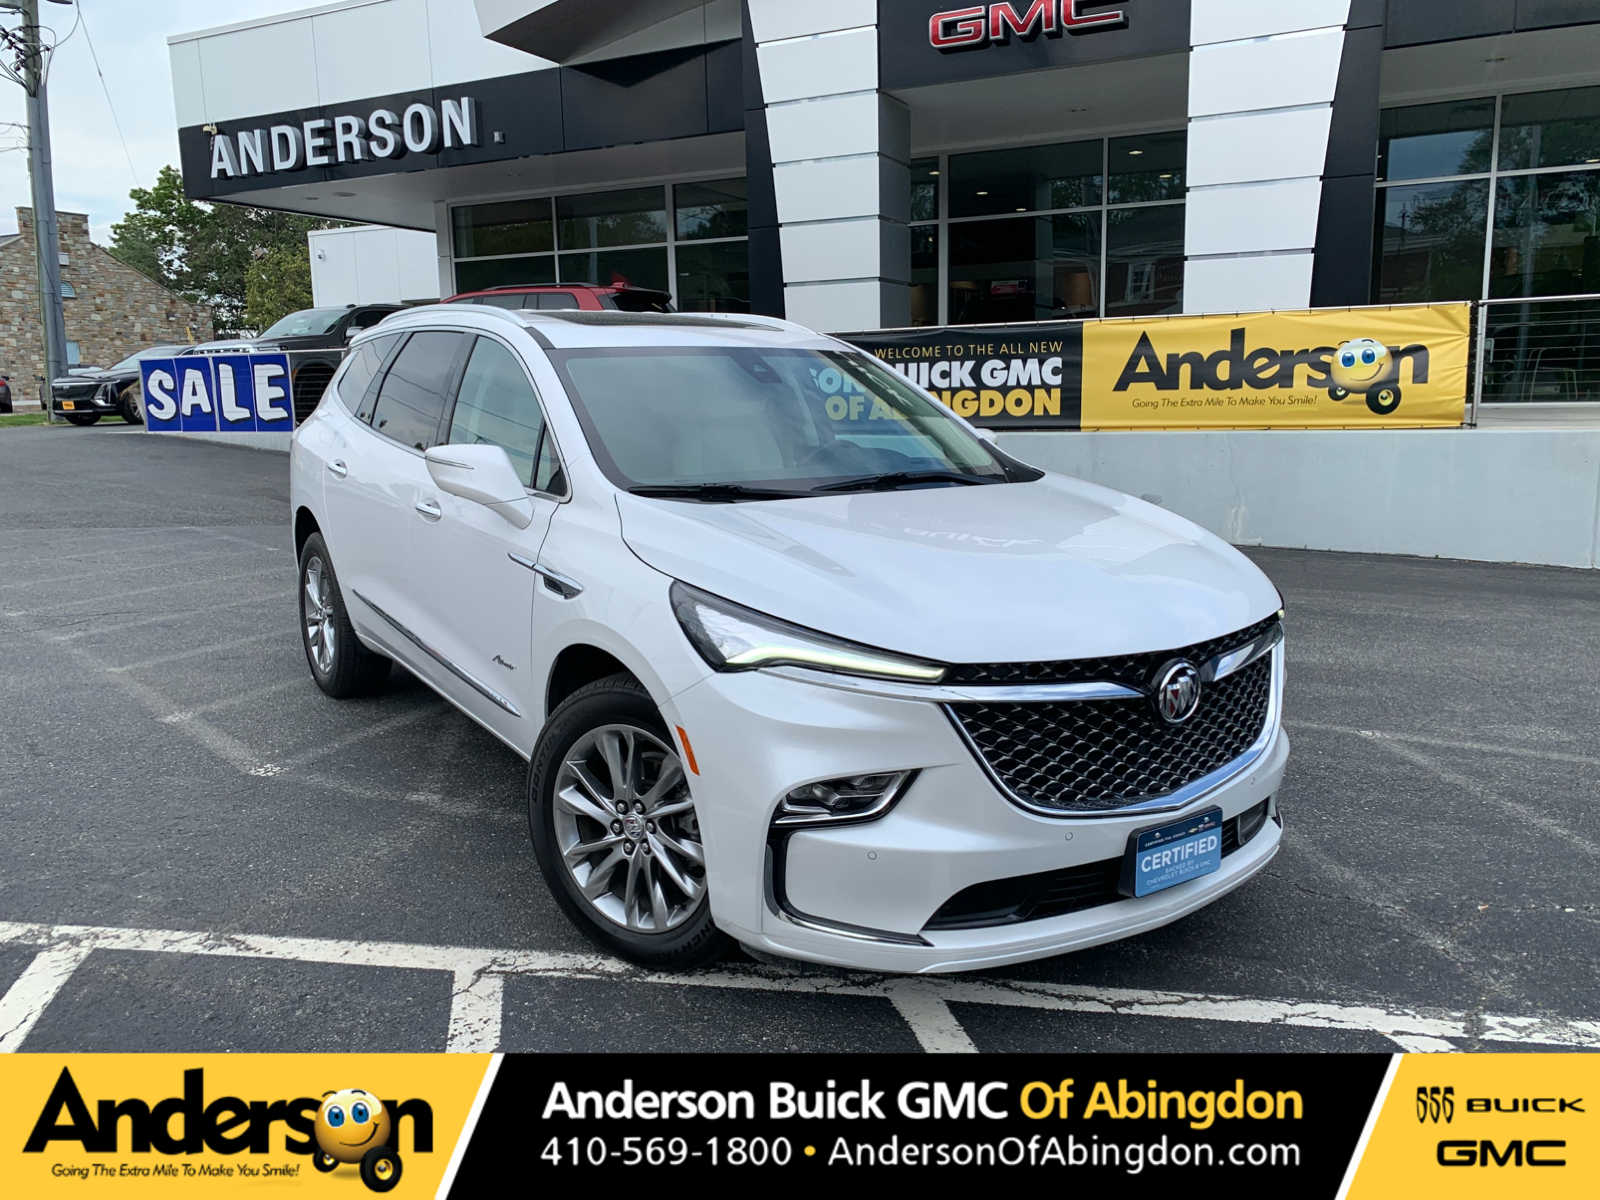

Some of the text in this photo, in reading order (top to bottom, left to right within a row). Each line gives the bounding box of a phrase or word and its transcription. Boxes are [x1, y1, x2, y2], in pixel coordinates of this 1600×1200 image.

[928, 0, 1125, 48] GMC
[209, 96, 477, 179] ANDERSON
[875, 341, 1063, 359] WELCOME TO THE ALL NEW
[894, 360, 977, 388] UICK
[980, 357, 1062, 387] GMC
[146, 363, 290, 422] SALE
[825, 395, 864, 420] OF
[1132, 394, 1318, 410] Going The Extra Mile To Make You Smile!
[1141, 835, 1217, 872] CERTIFIED
